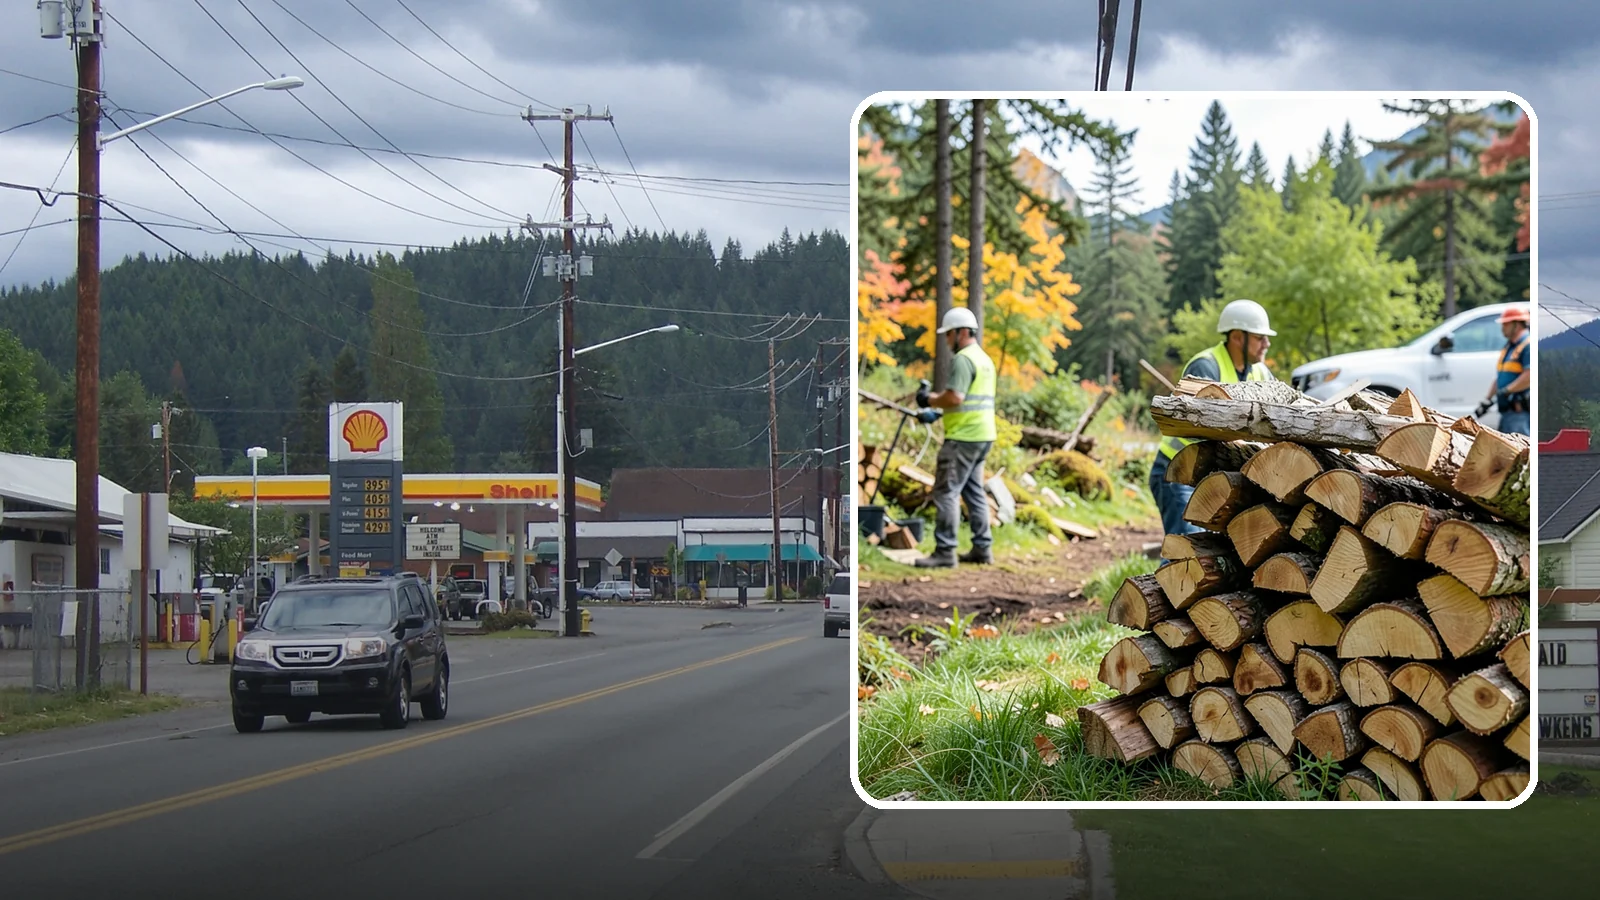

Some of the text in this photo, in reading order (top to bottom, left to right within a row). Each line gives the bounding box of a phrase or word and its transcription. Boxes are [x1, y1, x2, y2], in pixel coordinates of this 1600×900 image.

[366, 480, 383, 490] 395
[490, 484, 547, 499] Shell
[366, 494, 383, 504] 405
[366, 508, 383, 518] 415
[366, 522, 383, 532] 429
